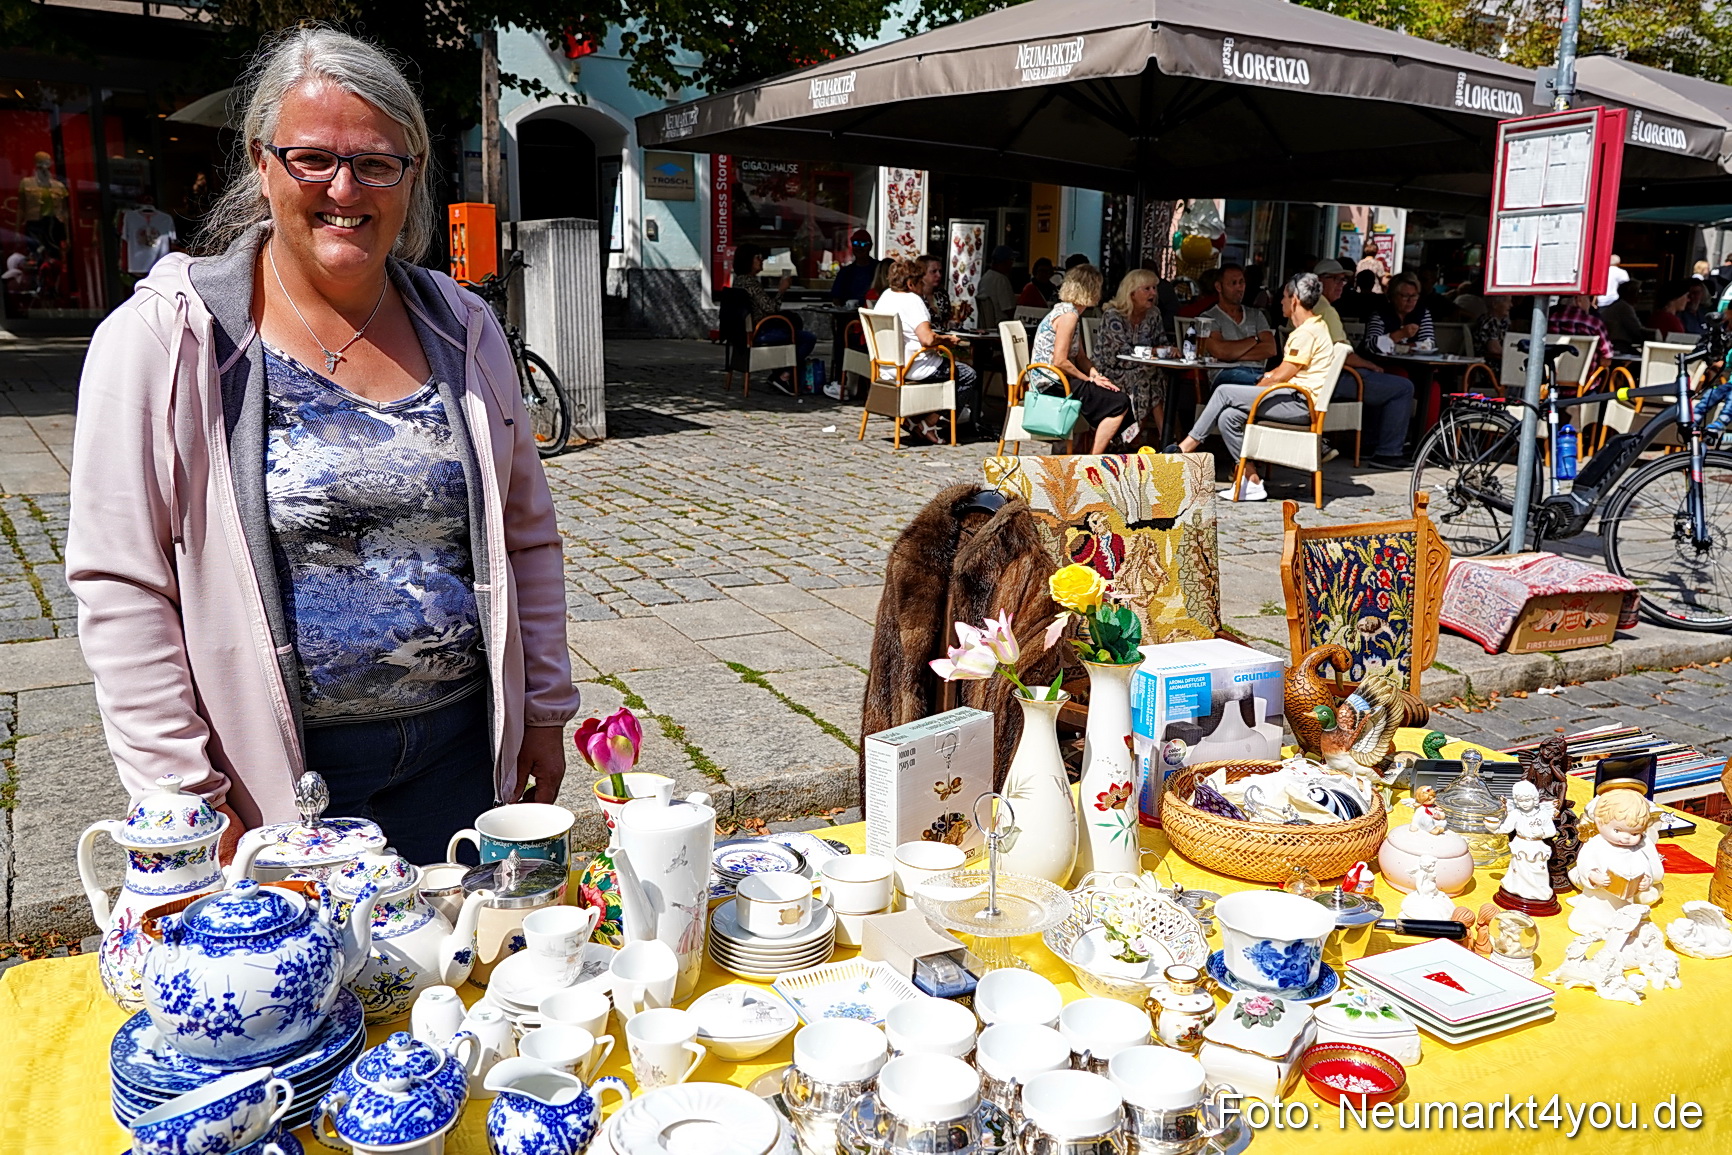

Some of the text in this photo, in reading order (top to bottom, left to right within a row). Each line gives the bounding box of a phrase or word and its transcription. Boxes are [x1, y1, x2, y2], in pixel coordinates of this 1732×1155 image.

[1015, 36, 1084, 69] NEUMARKTER
[1233, 50, 1310, 85] LORENZO
[808, 71, 857, 99] NEUMARKTER
[1464, 83, 1524, 115] LORENZO
[1638, 120, 1687, 150] LORENZO
[716, 154, 728, 253] Business Store
[1525, 634, 1608, 650] FIRST QUALITY BANANAS
[1184, 676, 1206, 684] DIFFUSER
[1233, 670, 1282, 683] GRUNDIG
